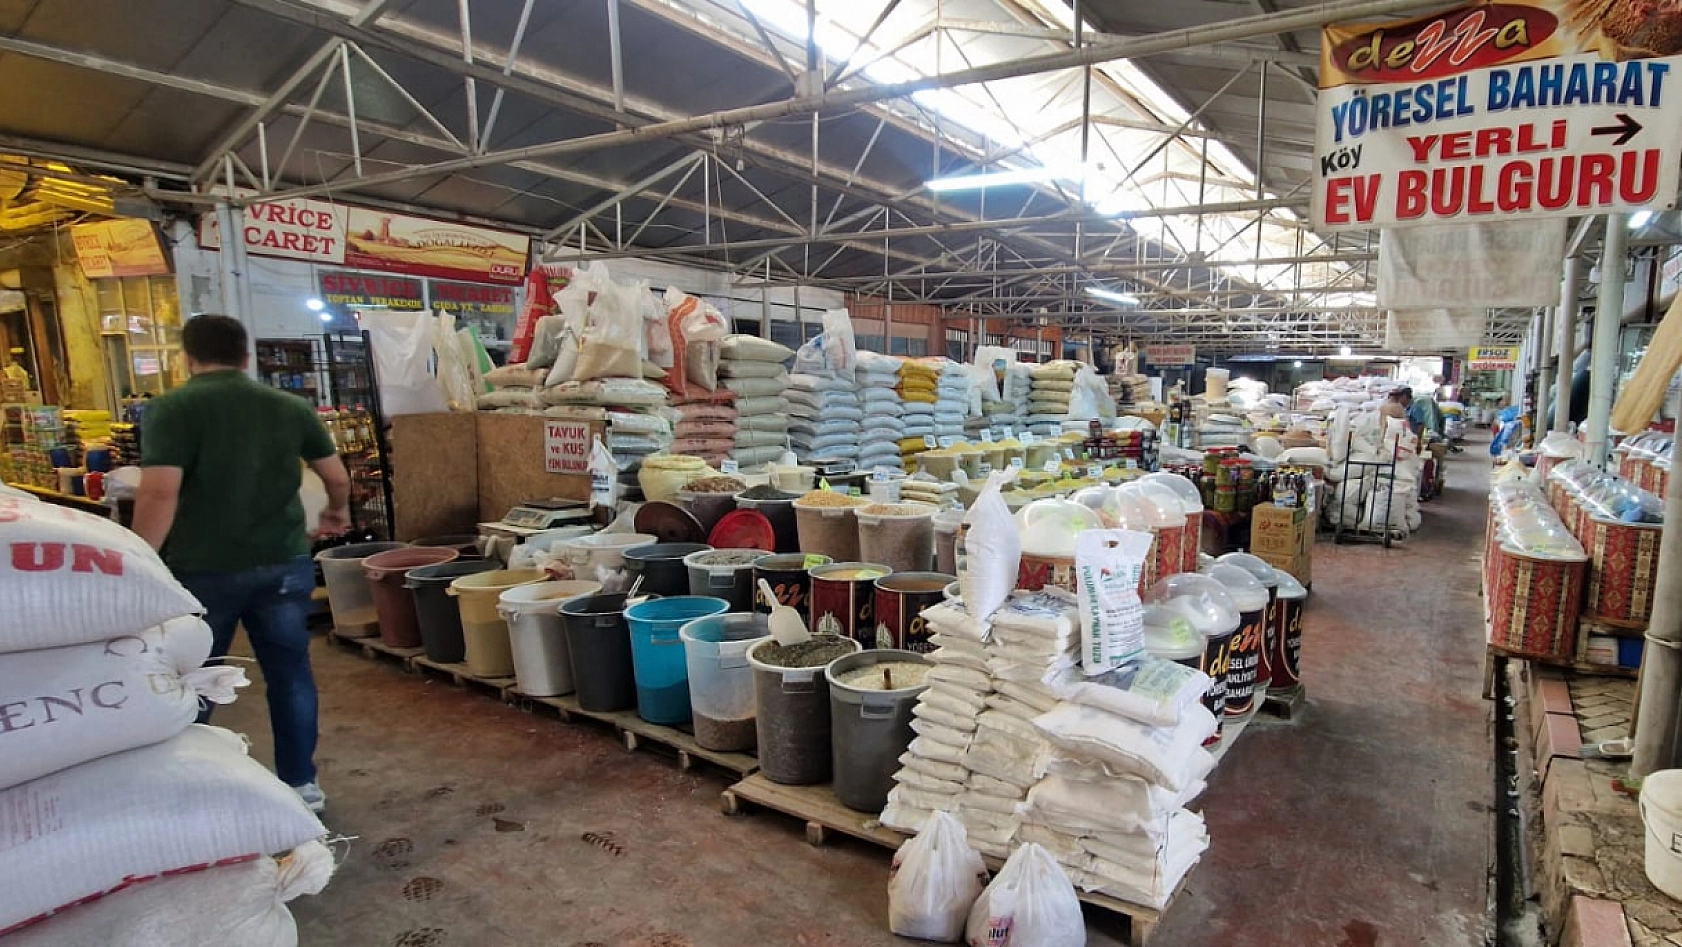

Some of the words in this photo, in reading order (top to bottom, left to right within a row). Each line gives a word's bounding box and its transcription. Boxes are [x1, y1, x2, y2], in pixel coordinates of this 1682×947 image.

[1348, 10, 1531, 73] dezza
[1331, 75, 1474, 143] YÖRESEL
[1488, 61, 1671, 111] BAHARAT
[1407, 119, 1568, 164] YERLİ
[1321, 144, 1363, 177] Köy
[1325, 173, 1382, 224] EV
[1395, 149, 1661, 221] BULGURU
[249, 202, 333, 230] VRİCE
[244, 227, 336, 255] CARET
[491, 265, 518, 275] DURU
[547, 426, 586, 439] TAVUK
[9, 541, 124, 576] UN
